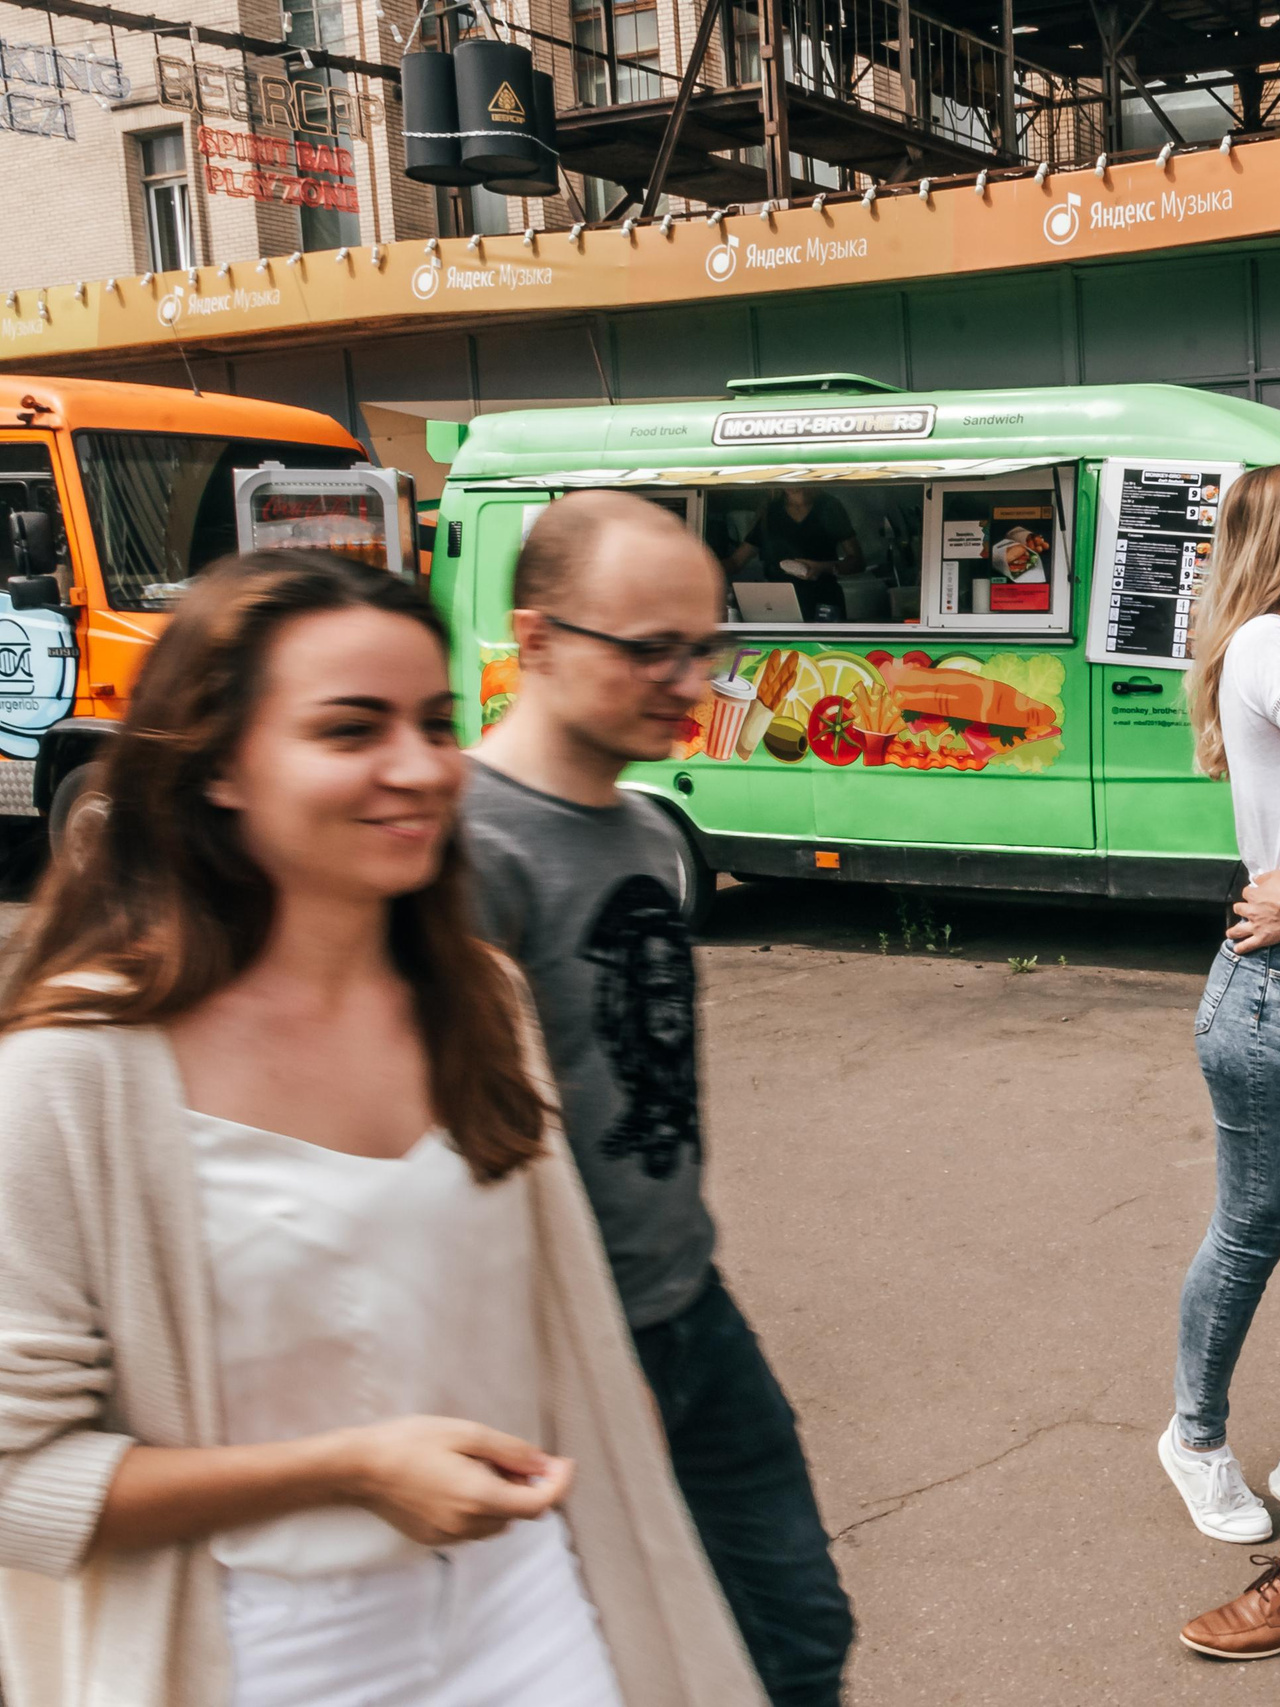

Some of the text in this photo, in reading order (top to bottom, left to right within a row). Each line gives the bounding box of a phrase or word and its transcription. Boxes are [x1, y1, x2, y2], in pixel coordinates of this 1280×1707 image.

[154, 53, 387, 142] BEERCAP
[197, 125, 354, 177] SPIRIT BAR
[204, 164, 360, 213] PLAY ZONE
[1089, 188, 1233, 230] Яндекс Музыка
[745, 236, 868, 270] Яндекс Музыка
[446, 263, 552, 291] Яндекс Музыка
[188, 287, 280, 316] Яндекс Музыка
[2, 317, 44, 339] Музыка
[630, 425, 688, 438] Food truck
[723, 412, 924, 436] MONKEY-BROTHERS
[963, 413, 1024, 426] Sandwich
[1191, 490, 1198, 498] 9
[1189, 509, 1196, 517] 9
[1184, 571, 1191, 580] 9
[0, 697, 40, 713] rgerlab
